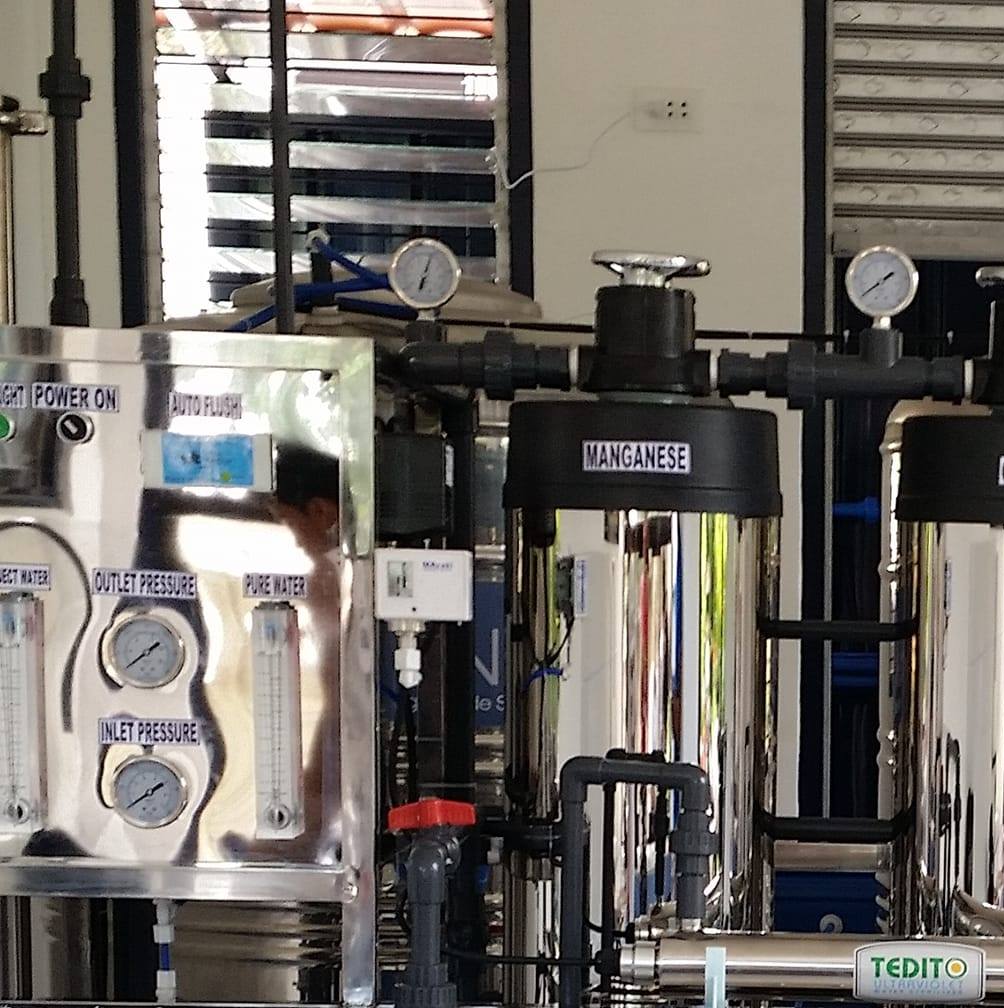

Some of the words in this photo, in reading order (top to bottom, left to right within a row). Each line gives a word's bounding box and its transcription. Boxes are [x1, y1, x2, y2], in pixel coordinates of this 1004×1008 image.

[35, 385, 89, 407] POWER
[94, 388, 116, 409] ON
[169, 394, 201, 416] AUTO
[203, 396, 240, 418] FLUSH
[587, 444, 686, 469] MANGANESE
[20, 569, 49, 586] WATER
[95, 571, 137, 593] OUTLET
[139, 574, 195, 596] PRESSURE
[246, 574, 271, 595] PURE
[273, 575, 305, 596] WATER
[101, 721, 134, 741] INLET
[138, 722, 198, 743] PRESSURE
[870, 957, 968, 979] TEDITO
